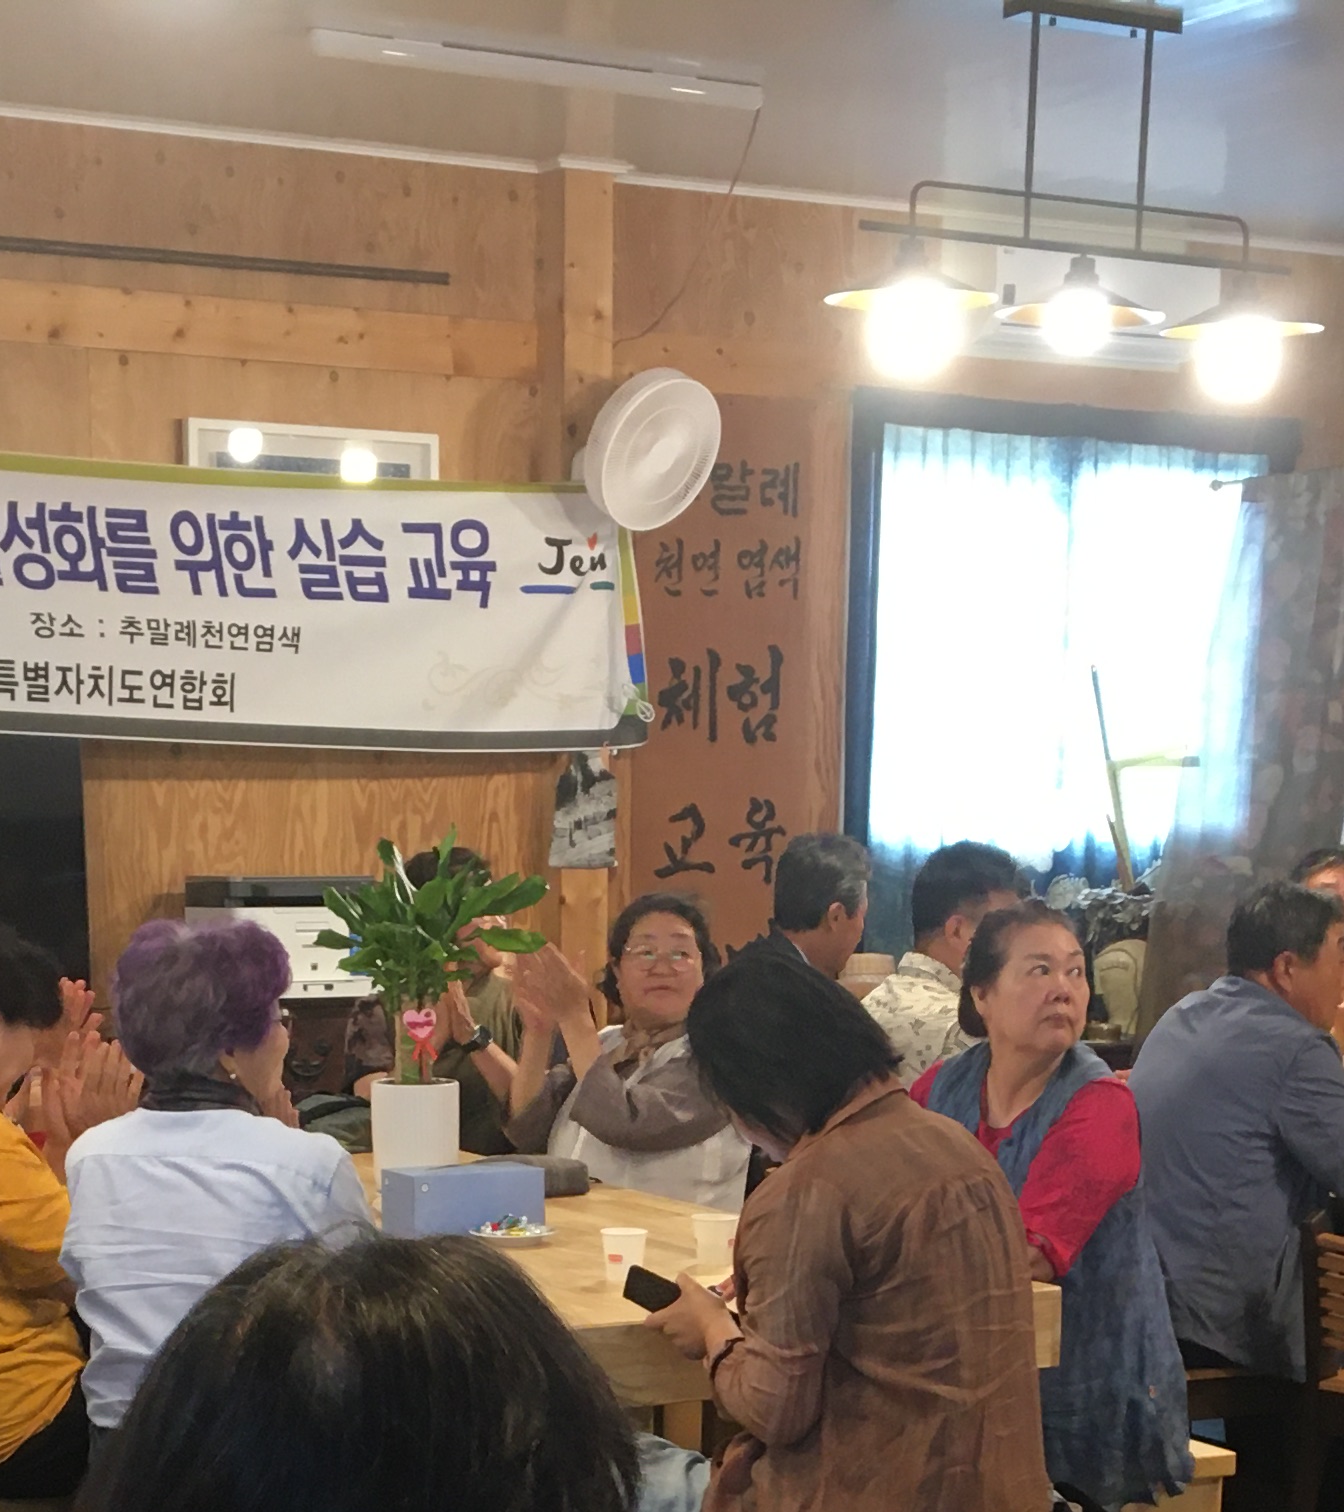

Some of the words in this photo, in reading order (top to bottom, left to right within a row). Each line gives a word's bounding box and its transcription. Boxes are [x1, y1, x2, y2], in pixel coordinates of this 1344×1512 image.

[709, 459, 800, 518] 말례
[169, 508, 278, 599] 위한
[287, 517, 391, 604] 실습
[401, 518, 498, 609] 교육
[654, 537, 722, 597] 천연
[736, 536, 802, 600] 염색
[29, 611, 86, 639] 장소
[119, 615, 302, 655] 추말례천연염색
[657, 644, 784, 744] 체험
[654, 796, 787, 884] 교육
